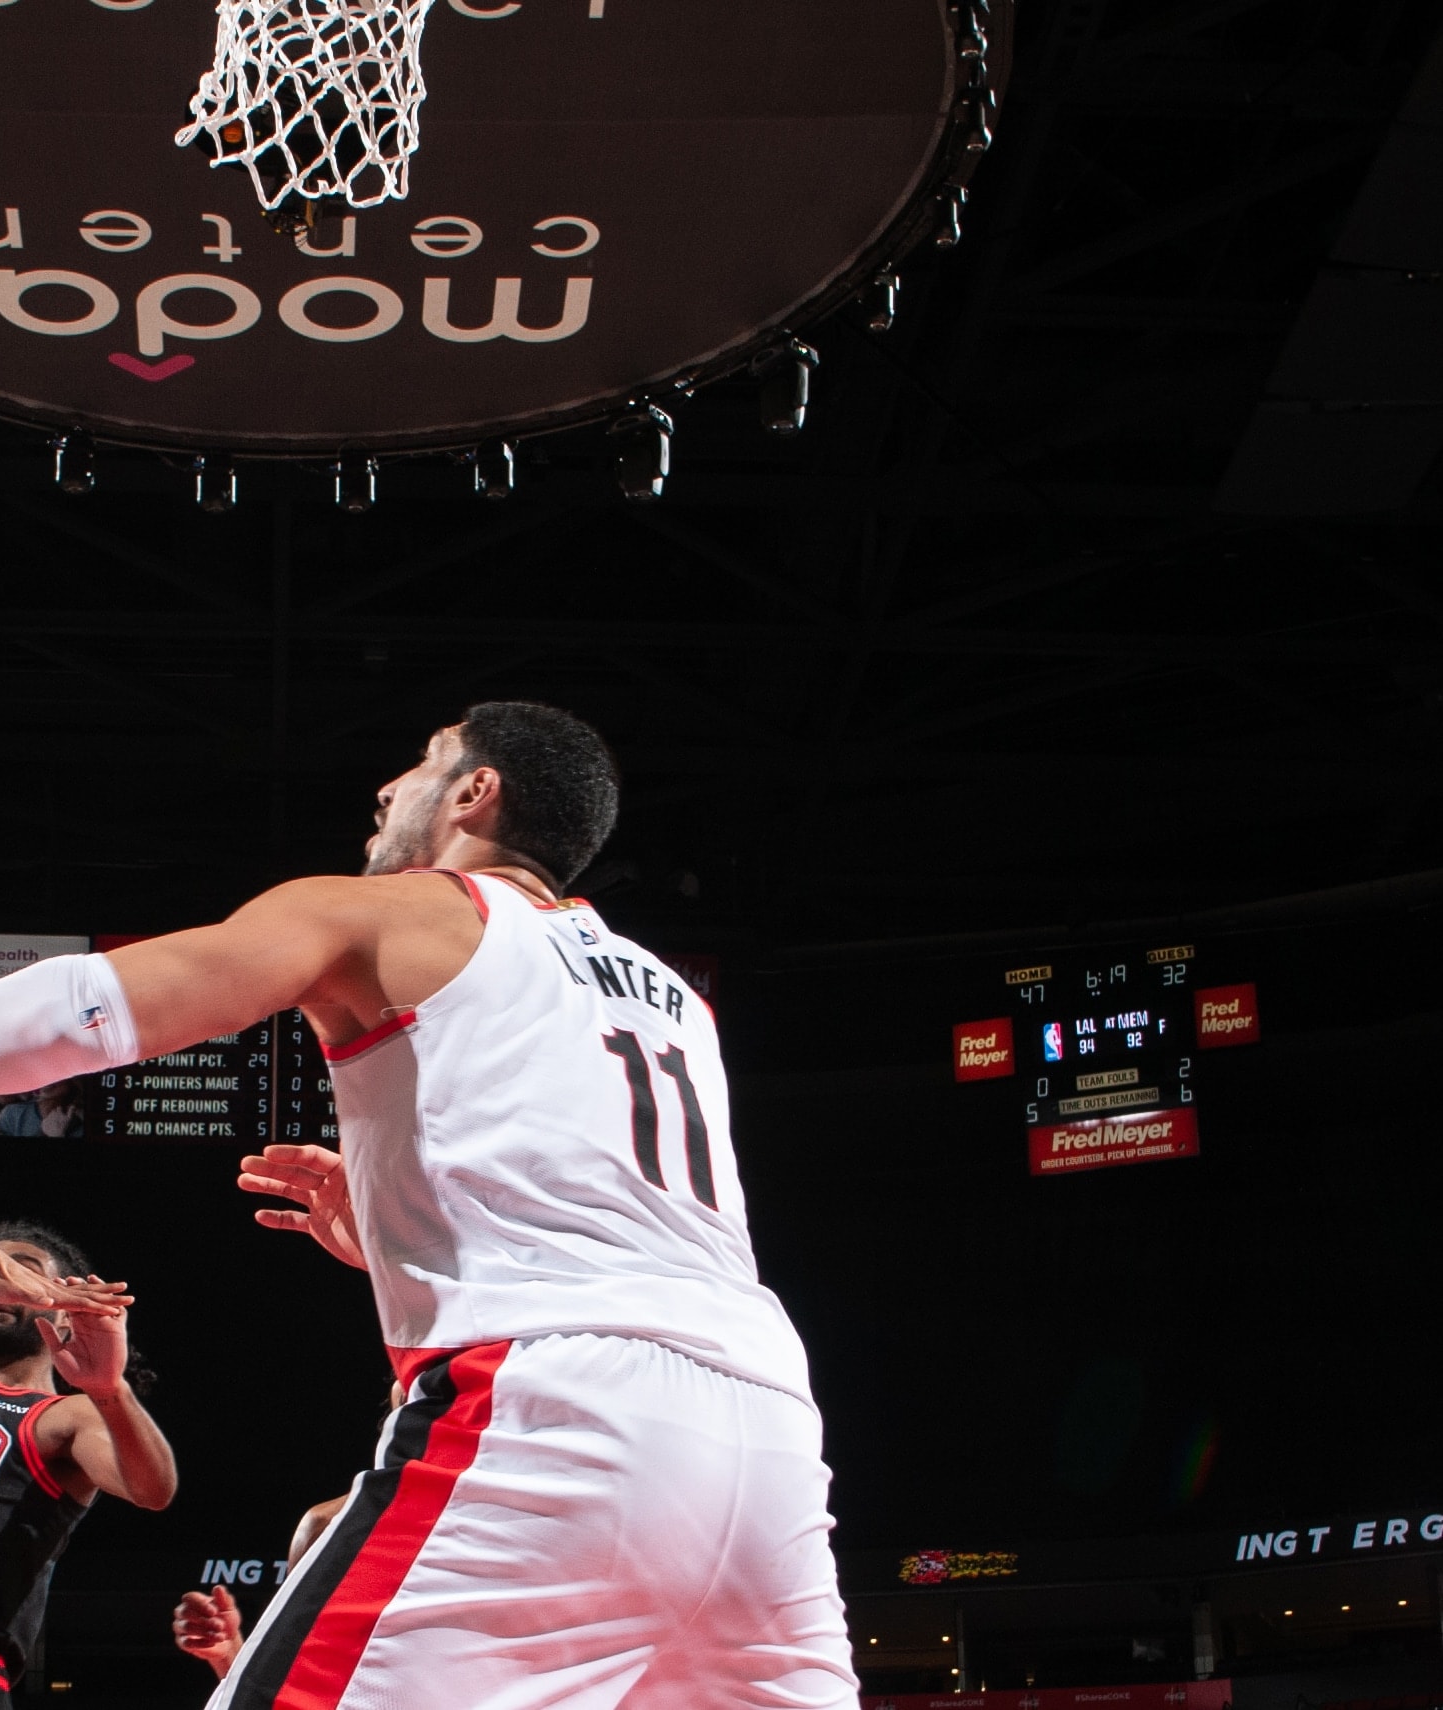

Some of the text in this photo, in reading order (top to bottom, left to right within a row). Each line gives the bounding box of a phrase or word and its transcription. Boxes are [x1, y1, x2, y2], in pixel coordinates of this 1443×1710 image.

[1008, 946, 1194, 989] HOME 6:19 GUEST
[1020, 964, 1186, 1004] 47 32
[1202, 998, 1239, 1018] Fred
[1076, 1010, 1166, 1035] LAL AT MEM F
[1201, 1015, 1252, 1034] Meyer
[260, 1030, 269, 1045] 3
[292, 1031, 302, 1045] 9
[959, 1033, 996, 1052] Fred
[1079, 1031, 1143, 1055] 94 92
[157, 1053, 268, 1068] POINT PCT. 29
[294, 1054, 302, 1068] 7
[959, 1049, 1008, 1069] Meyer
[101, 1073, 116, 1089] 10
[143, 1076, 202, 1090] POINTERS
[206, 1076, 239, 1091] MADE
[259, 1076, 268, 1091] 5
[291, 1077, 302, 1092] 0
[1037, 1058, 1191, 1098] 0 TEAM FOULS 2
[106, 1096, 267, 1114] 3 OFF REBOUNDS 5
[291, 1100, 302, 1113] 4
[1027, 1083, 1193, 1123] 5 TIME OUTS REMAINING 6
[105, 1120, 267, 1137] 5 2ND CHANCE PTS. 5
[601, 1025, 720, 1213] 11
[286, 1122, 301, 1137] 13
[1041, 1157, 1065, 1169] ORDER
[1107, 1150, 1125, 1161] PICK
[1126, 1149, 1136, 1159] UP
